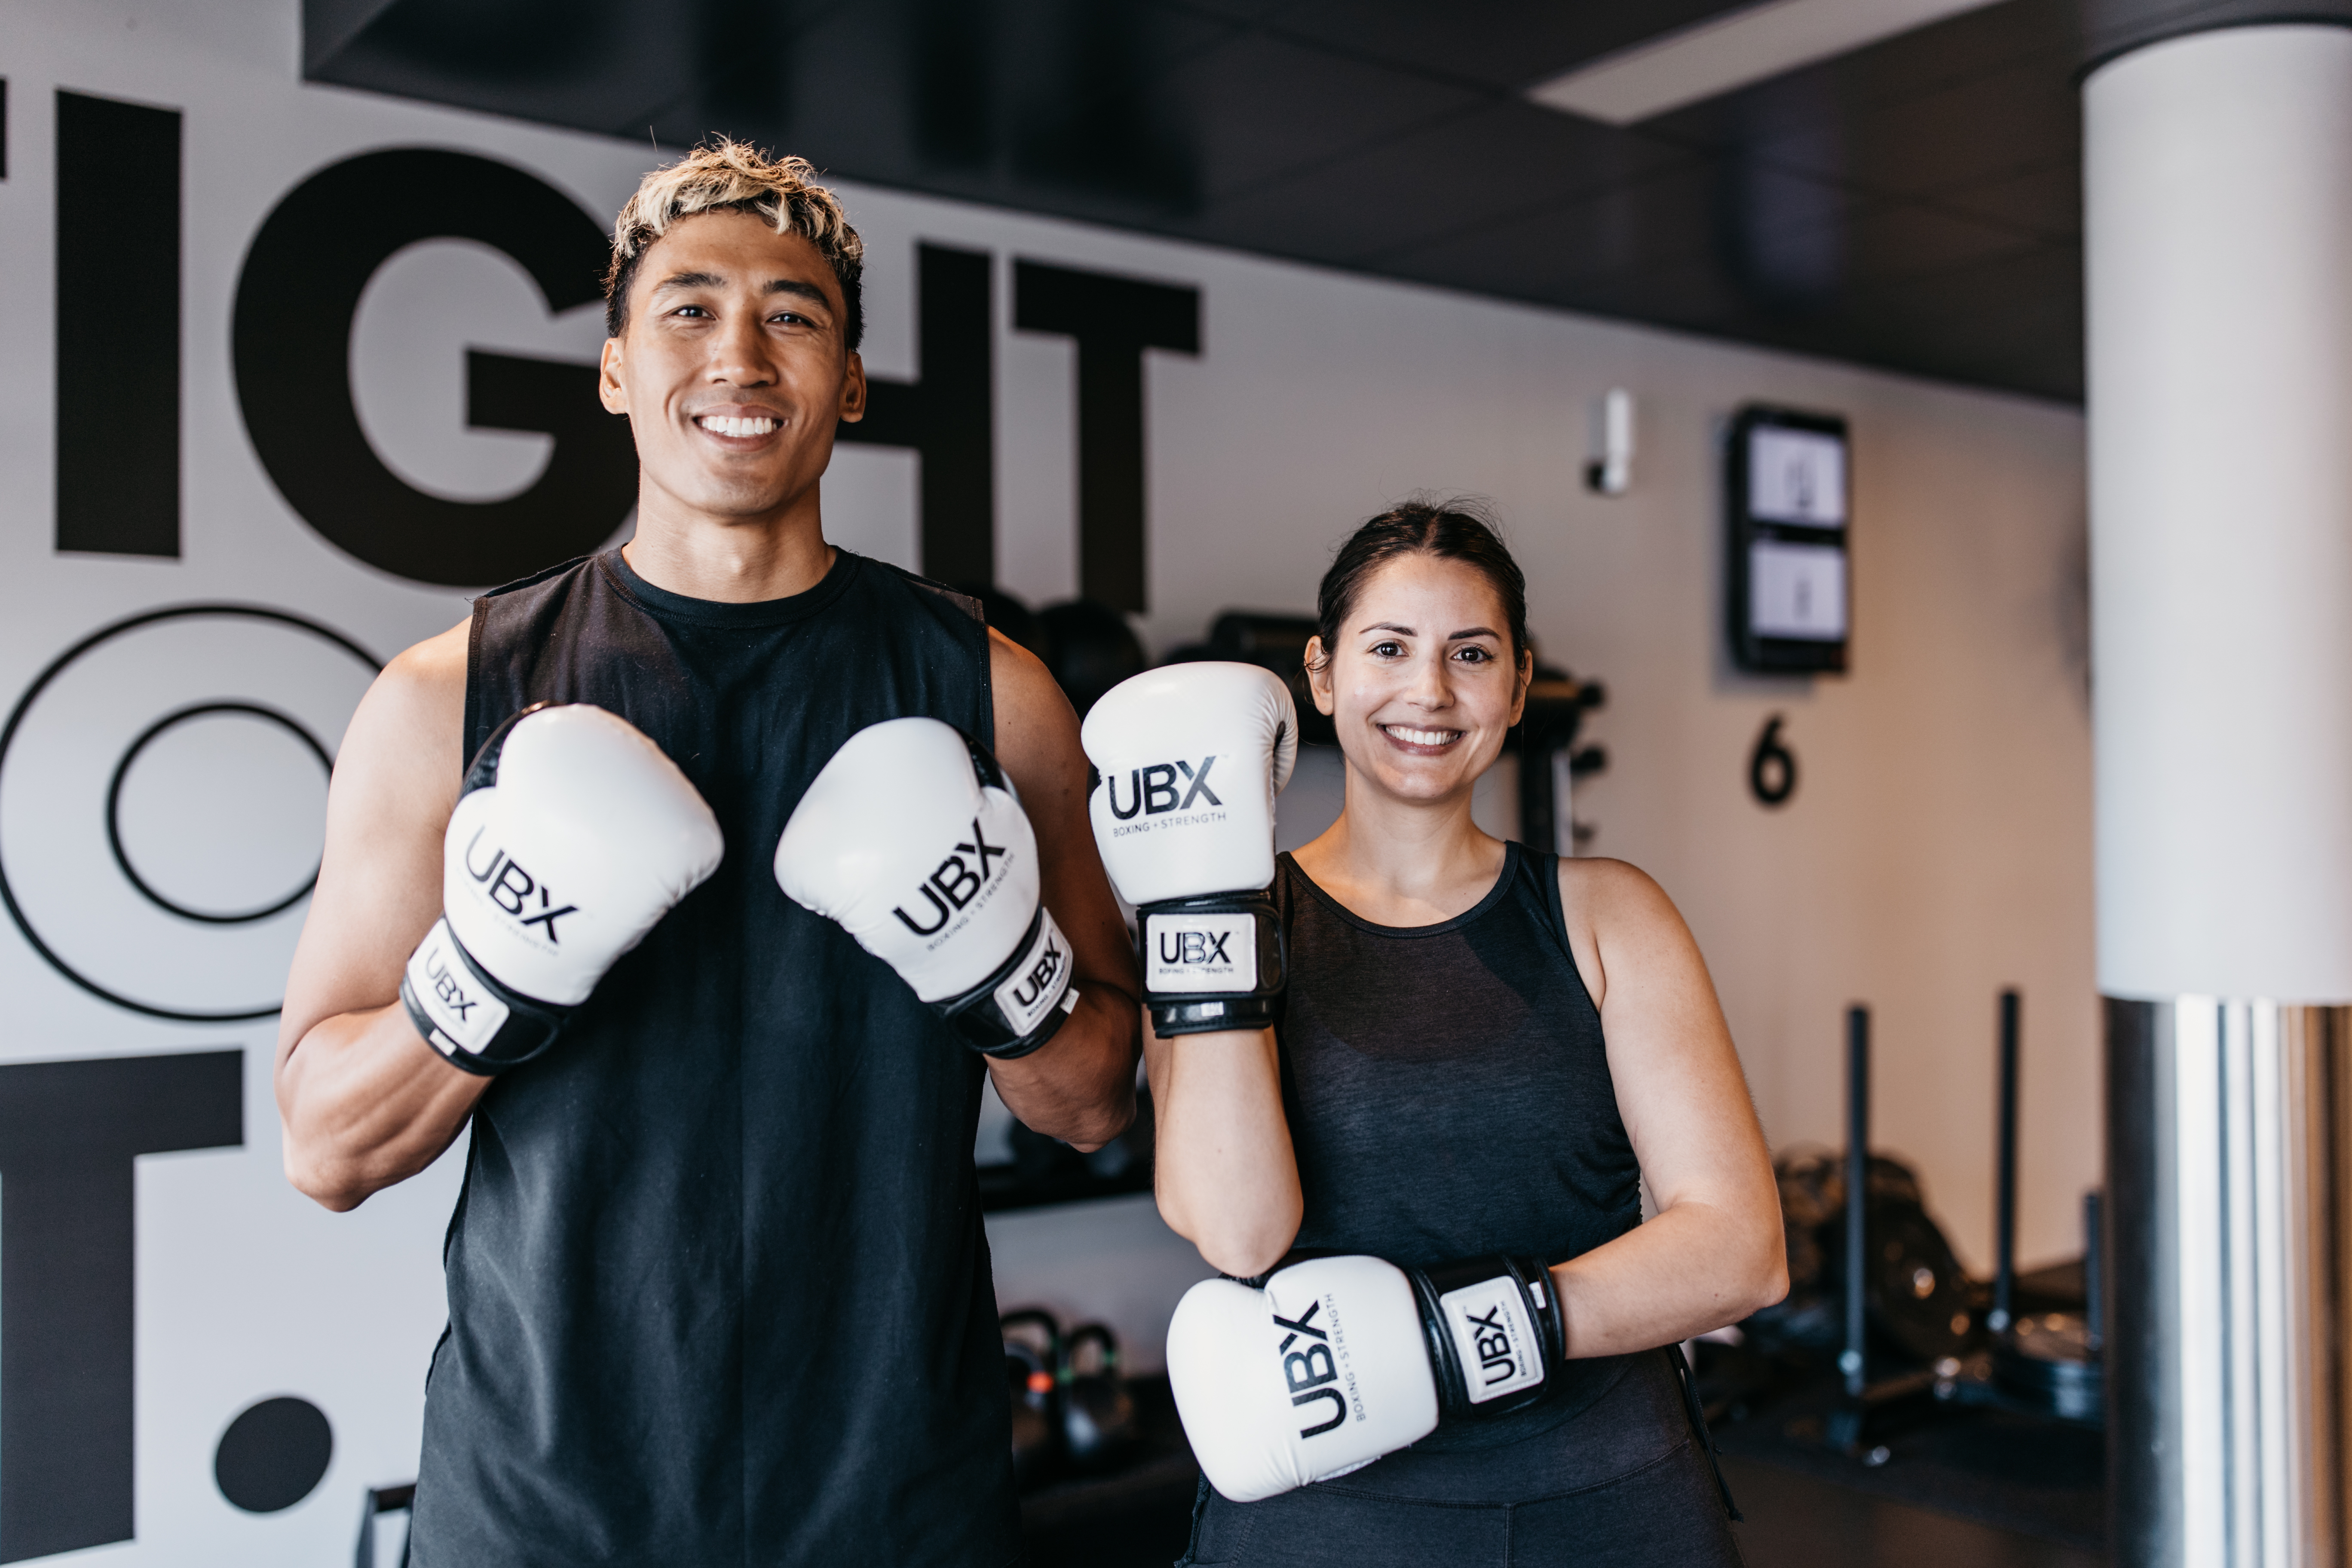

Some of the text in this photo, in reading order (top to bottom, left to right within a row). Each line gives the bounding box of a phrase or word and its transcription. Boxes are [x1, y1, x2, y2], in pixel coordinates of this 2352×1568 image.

[0, 77, 1204, 613] IGHT
[1108, 755, 1223, 820] UBX
[1748, 712, 1798, 811] 6
[1113, 822, 1150, 838] BOXING
[1161, 812, 1226, 830] STRENGTH
[466, 824, 579, 946] UBX
[891, 817, 1006, 937] UBX
[926, 915, 970, 952] BOXING
[974, 851, 1015, 910] STRENGTH
[426, 948, 478, 1023] UBX
[1013, 935, 1061, 1008] UBX
[1160, 931, 1232, 965] UBX
[1026, 994, 1049, 1018] BOXING
[1324, 1292, 1350, 1360] STRENGTH
[1466, 1305, 1516, 1387] UBX
[1272, 1299, 1347, 1440] UBX
[1345, 1371, 1366, 1422] BOXING
